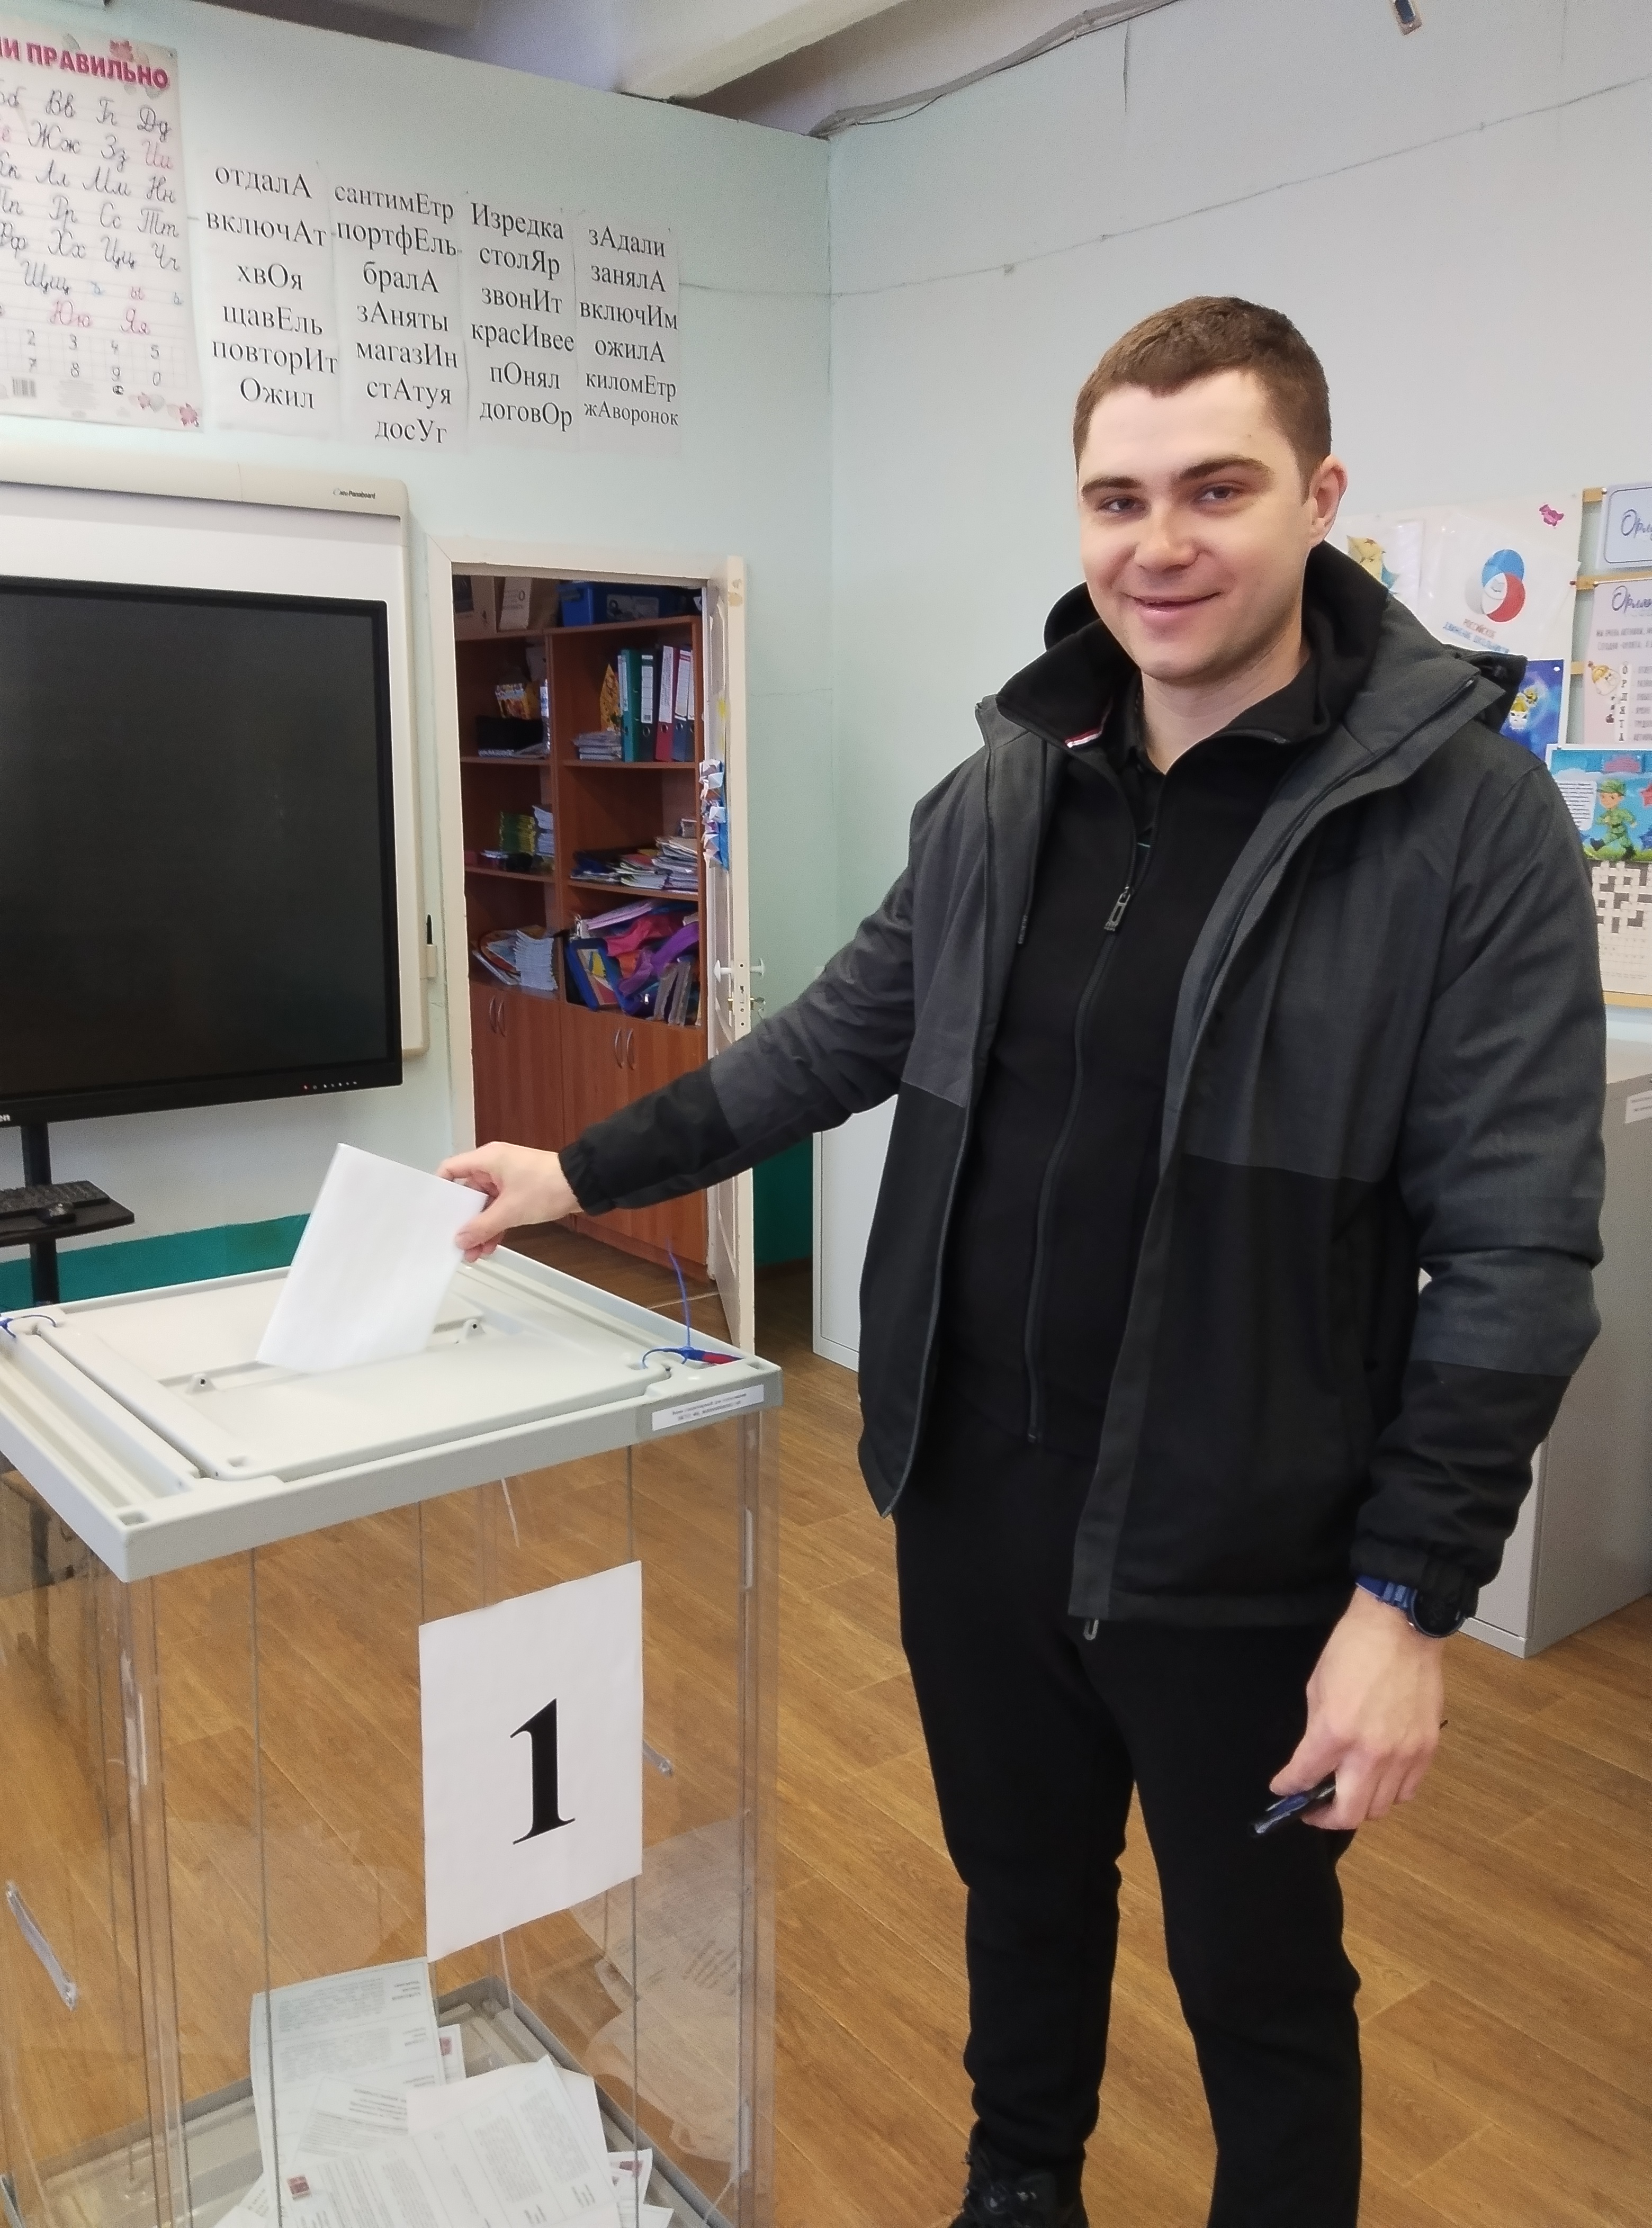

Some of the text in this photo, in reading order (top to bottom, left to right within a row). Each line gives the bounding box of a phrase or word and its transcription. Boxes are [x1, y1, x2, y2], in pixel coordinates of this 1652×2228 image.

[0, 37, 168, 89] И ПРАВИЛЬНО
[137, 105, 172, 142] Дд
[28, 121, 80, 154] Жж
[101, 134, 129, 172] Зз
[35, 159, 69, 187] Лл
[83, 166, 131, 197] Мм
[147, 175, 176, 203] Нн
[215, 167, 312, 199] отдалА
[100, 202, 121, 229] Сс
[138, 207, 179, 237] Тт
[335, 186, 454, 225] сантимЕтр
[471, 202, 564, 240] Изредка
[206, 212, 327, 247] включАт
[337, 222, 456, 256] портфЕль
[589, 226, 666, 258] зАдали
[100, 236, 135, 269] Цц
[151, 242, 181, 271] Чч
[479, 247, 560, 281] столЯр
[21, 260, 71, 295] Щщ
[238, 263, 302, 291] хвОя
[363, 260, 439, 293] бралА
[591, 265, 666, 292] занялА
[50, 300, 90, 328] Юю
[356, 300, 448, 332] зАняты
[481, 288, 563, 314] звонИт
[580, 302, 678, 330] включИм
[223, 306, 323, 336] щавЕль
[27, 329, 160, 360] 2 3 4 5
[471, 323, 574, 352] красИвее
[595, 339, 666, 363] ожилА
[212, 341, 338, 375] повторИт
[356, 342, 458, 369] магазИн
[70, 362, 80, 378] 8
[111, 366, 121, 382] 9
[490, 362, 560, 390] пОнял
[586, 373, 676, 402] киломЕтр
[240, 378, 314, 410] Ожил
[366, 377, 452, 410] стАтуя
[479, 402, 572, 433] договОр
[583, 400, 678, 426] жАворонок
[374, 418, 447, 444] досУг
[510, 1697, 576, 1845] 1
